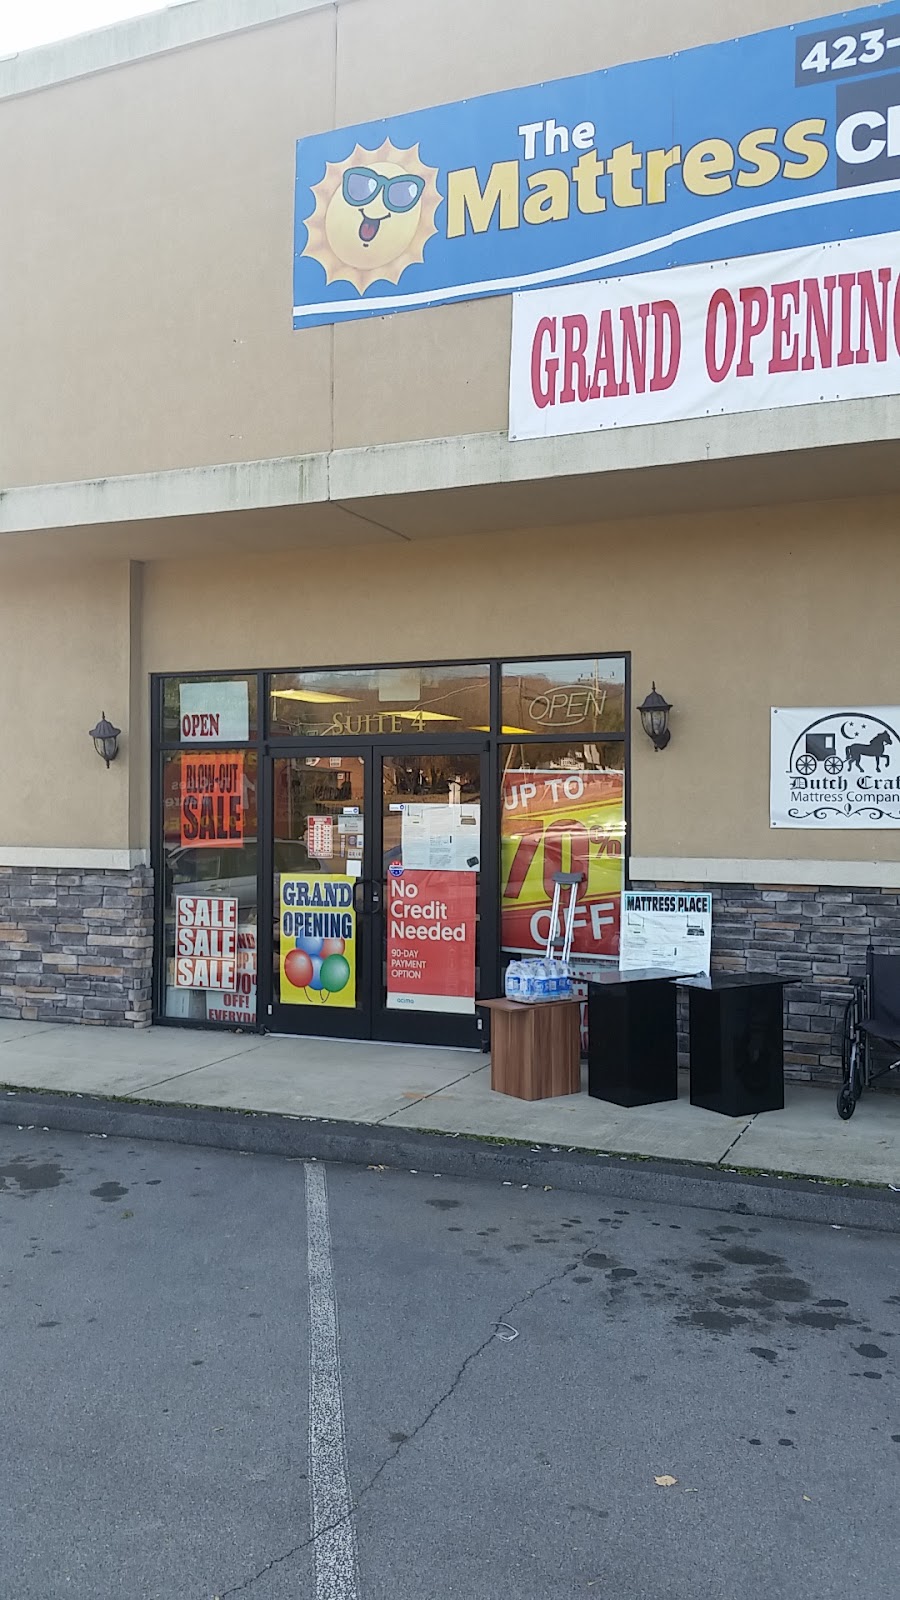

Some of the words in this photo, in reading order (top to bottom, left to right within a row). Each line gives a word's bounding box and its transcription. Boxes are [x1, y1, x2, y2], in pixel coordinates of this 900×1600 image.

[518, 119, 596, 160] The
[445, 118, 830, 240] Mattress
[530, 298, 682, 409] GRAND
[705, 267, 900, 383] OPENIN
[529, 690, 607, 720] OPEN
[182, 713, 220, 737] OPEN
[332, 712, 402, 735] SUITE
[411, 709, 426, 732] 4
[186, 764, 238, 793] BLOW-OUT
[789, 776, 848, 792] Dutch
[504, 783, 537, 810] UP
[545, 775, 585, 803] TO
[790, 791, 843, 802] Mattress
[846, 791, 900, 804] Compan
[183, 795, 241, 840] SALE
[283, 882, 353, 907] GRAND
[391, 880, 418, 898] No
[179, 898, 235, 927] SALE
[391, 900, 448, 920] Credit
[626, 896, 676, 912] MATTRESS
[678, 897, 707, 912] PLACE
[283, 911, 352, 939] OPENING
[391, 921, 466, 942] Needed
[530, 902, 615, 946] OFF
[178, 928, 235, 958] SALE
[391, 949, 419, 958] 90-DAY
[177, 958, 235, 989] SALE
[391, 959, 427, 969] PAYMENT
[391, 969, 422, 979] OPTION
[223, 993, 250, 1008] OFF!
[208, 1008, 257, 1023] EVERYDA
